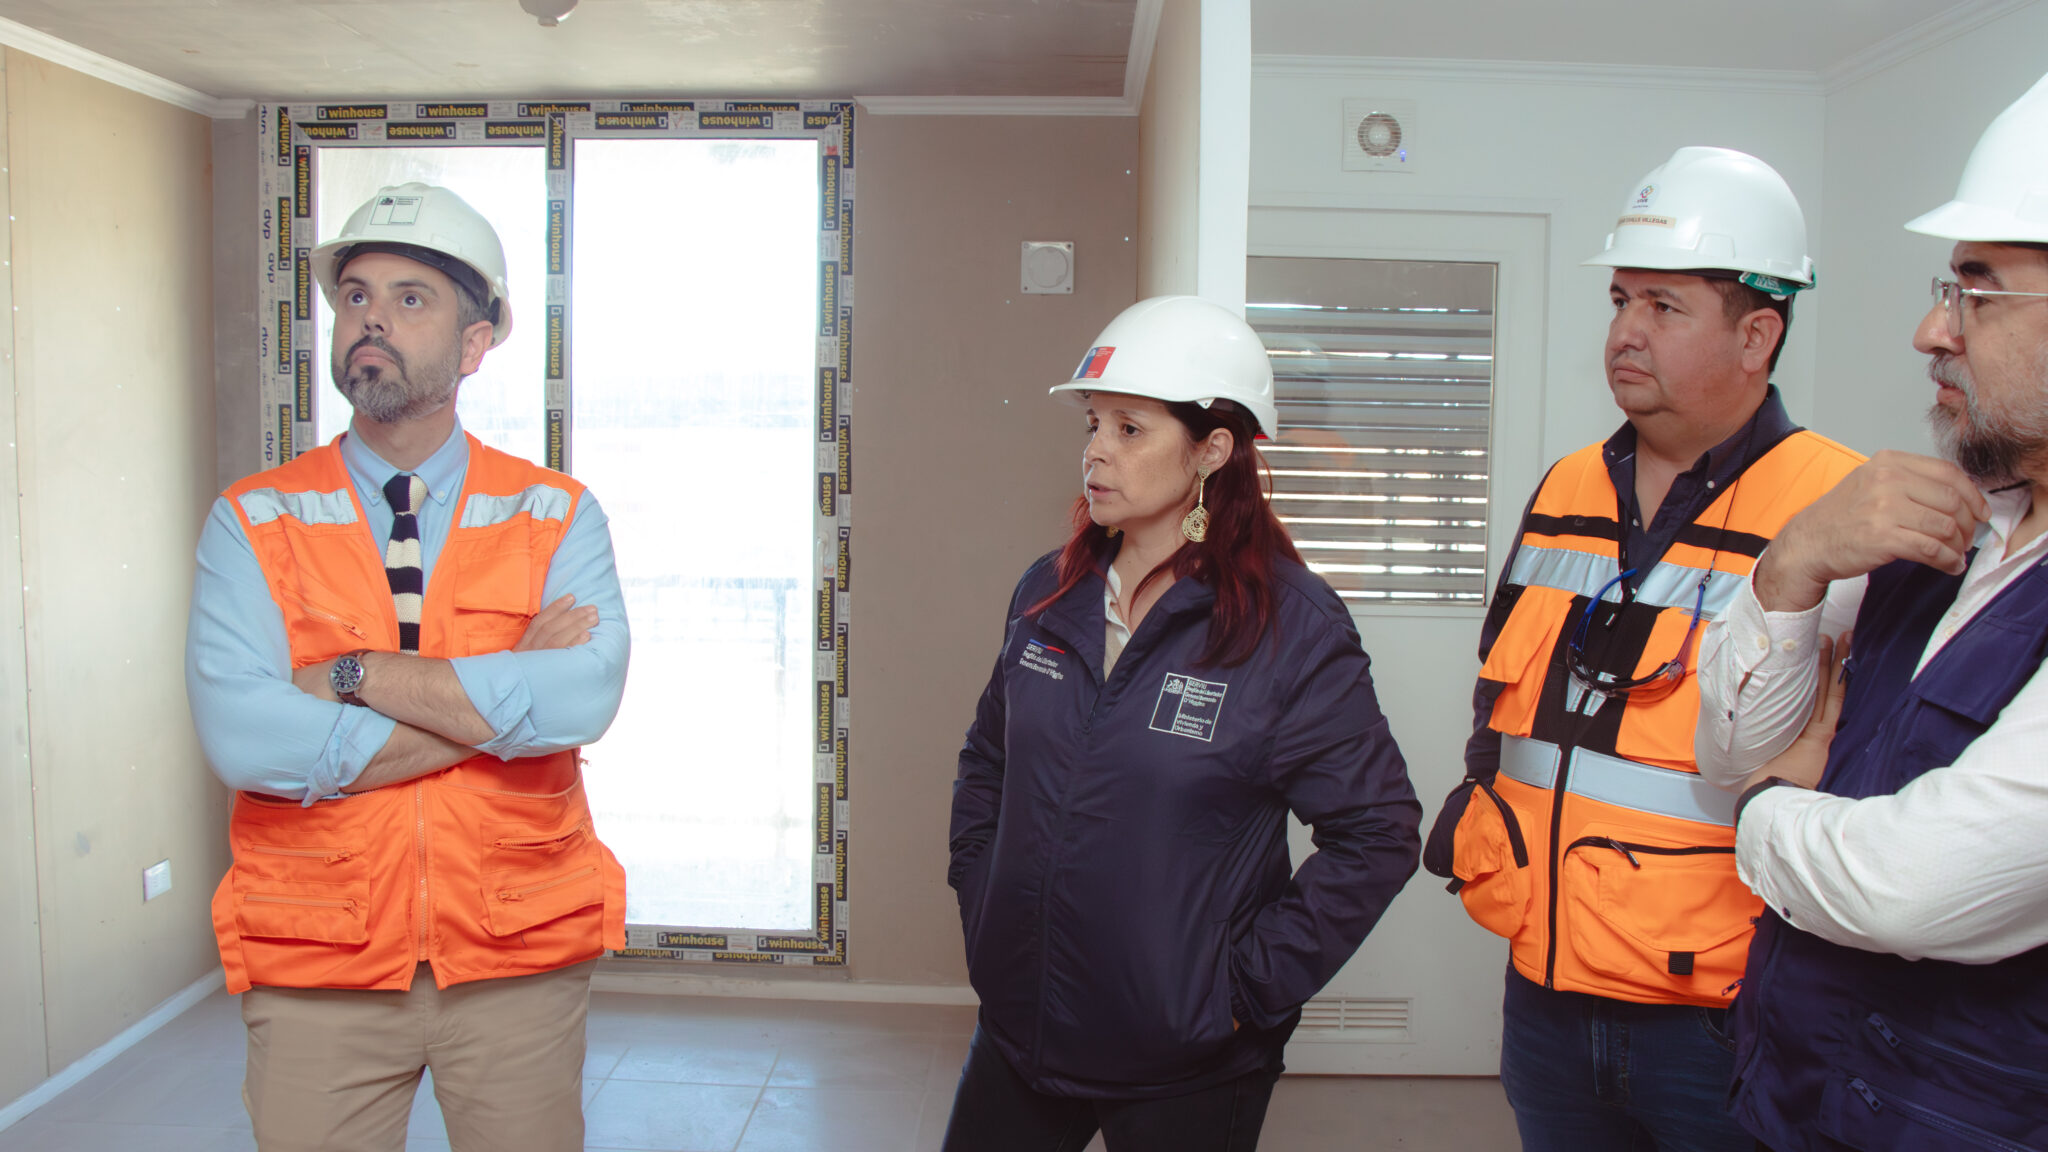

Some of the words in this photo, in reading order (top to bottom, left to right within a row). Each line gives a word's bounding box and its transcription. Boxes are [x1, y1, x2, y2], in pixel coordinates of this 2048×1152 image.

[329, 106, 385, 118] winhouse
[389, 126, 444, 138] winhouse
[428, 105, 485, 117] winhouse
[488, 126, 544, 137] winhouse
[599, 117, 655, 127] winhouse
[702, 116, 760, 127] winhouse
[299, 158, 310, 215] winhouse
[826, 159, 835, 217] winhouse
[263, 209, 272, 239] dvp
[280, 200, 289, 259] winhouse
[551, 214, 562, 271] winhouse
[841, 213, 849, 271] winhouse
[299, 260, 310, 317] winhouse
[825, 265, 834, 323] winhouse
[281, 304, 289, 362] winhouse
[551, 318, 562, 376] winhouse
[840, 319, 849, 379] winhouse
[299, 363, 310, 419] winhouse
[823, 370, 833, 430] winhouse
[265, 431, 274, 461] dvp
[839, 428, 848, 490] winhouse
[820, 581, 830, 638] winhouse
[837, 636, 845, 694] winhouse
[1188, 680, 1207, 689] SERVIU
[819, 684, 829, 741] winhouse
[837, 740, 845, 797] winhouse
[819, 786, 829, 841] winhouse
[669, 935, 725, 946] winhouse
[819, 886, 829, 941] winhouse
[769, 937, 825, 949] winhouse
